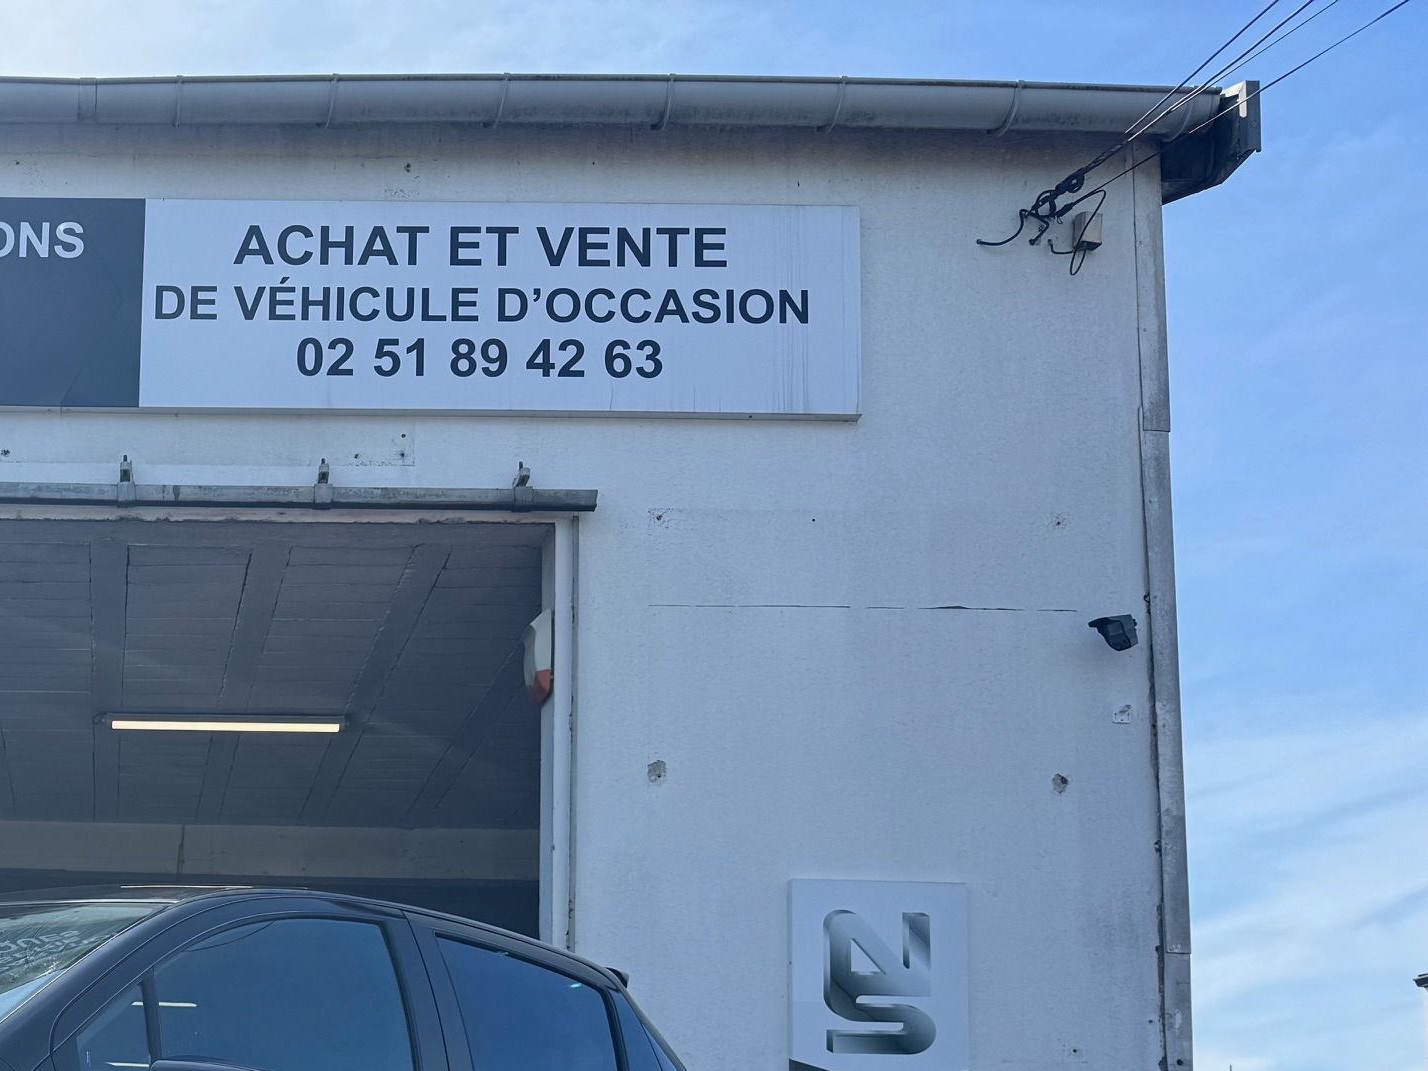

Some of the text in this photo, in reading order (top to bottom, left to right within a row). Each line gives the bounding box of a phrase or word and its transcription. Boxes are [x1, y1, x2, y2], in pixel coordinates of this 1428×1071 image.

[233, 224, 729, 269] ACHAT ET VENTE
[153, 277, 811, 325] DE VÉHICULE D’OCCASION
[295, 337, 664, 380] 02 51 89 42 63
